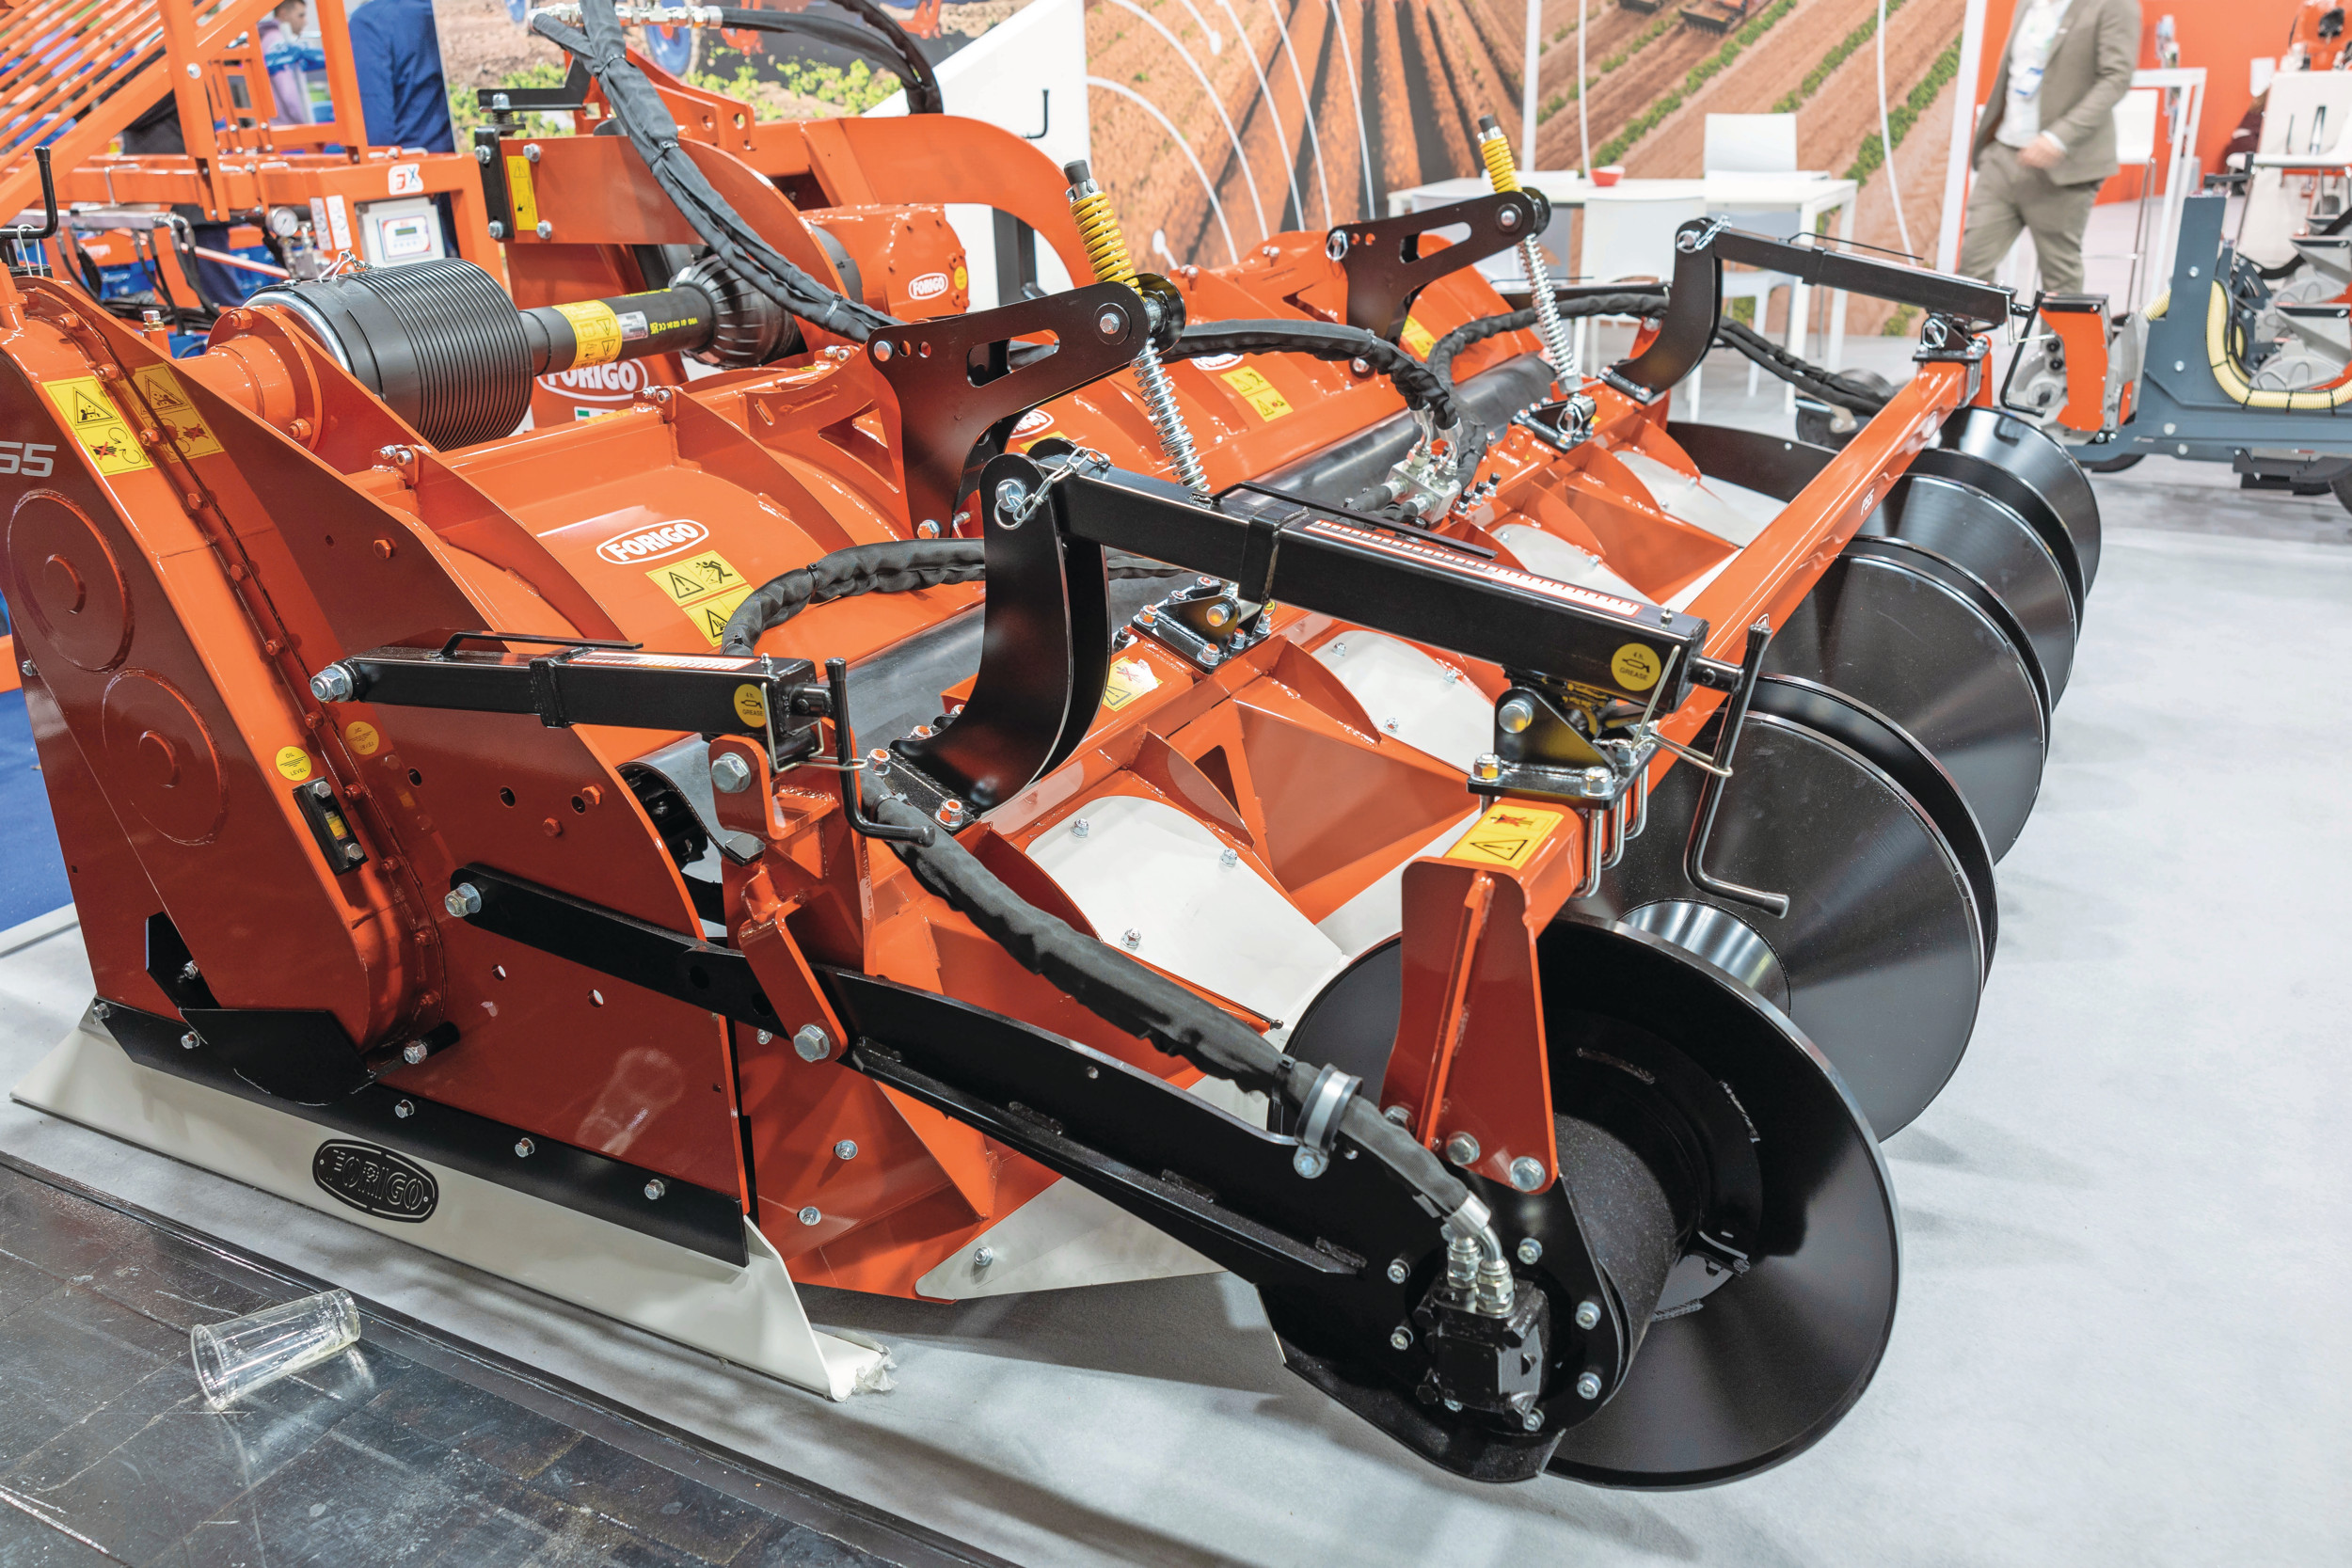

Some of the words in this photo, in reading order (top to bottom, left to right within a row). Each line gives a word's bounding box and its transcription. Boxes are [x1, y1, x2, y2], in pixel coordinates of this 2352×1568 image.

[912, 276, 946, 296] FORIGO
[604, 523, 699, 562] FORIGO
[1619, 667, 1648, 681] GREASE
[742, 708, 764, 717] GREASE
[290, 768, 307, 777] LEVEL
